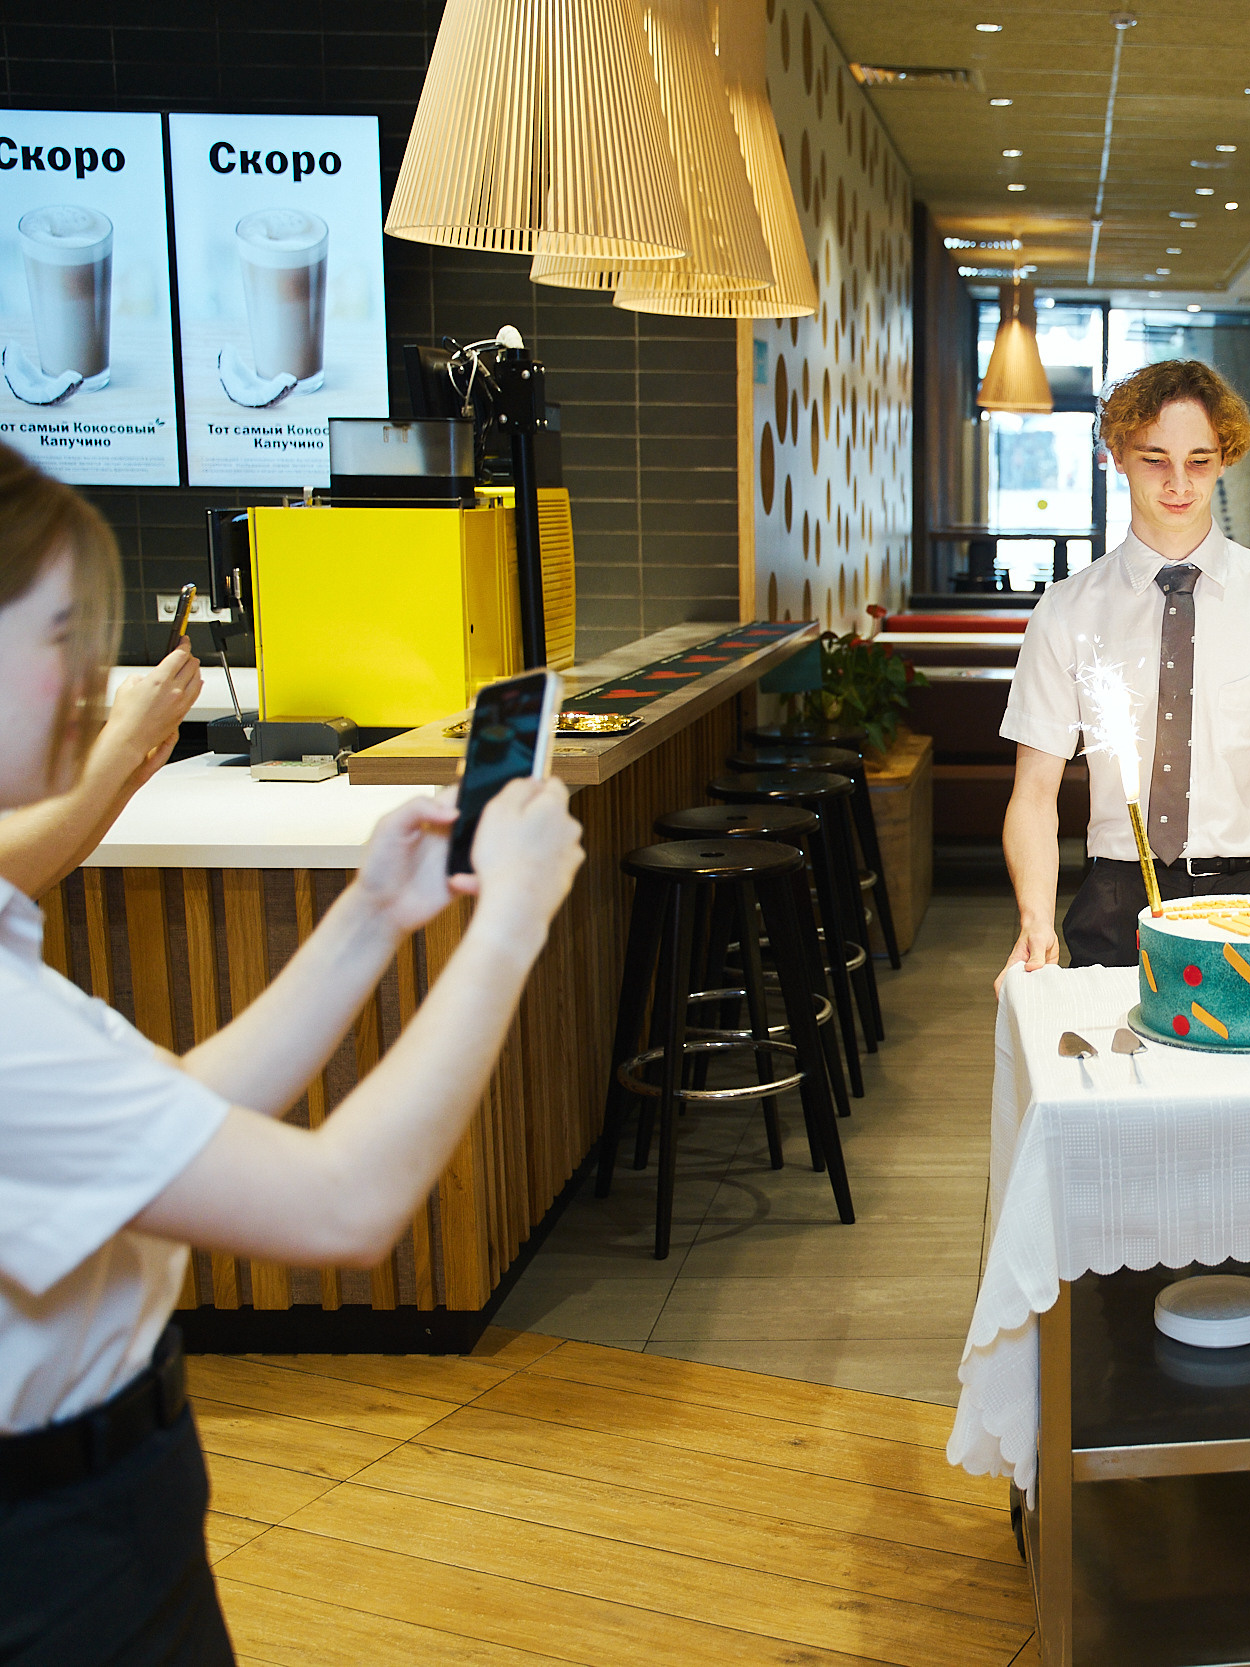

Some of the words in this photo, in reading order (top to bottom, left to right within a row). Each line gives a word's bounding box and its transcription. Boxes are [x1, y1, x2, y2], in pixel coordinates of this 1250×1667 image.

[0, 136, 126, 179] Скоро
[209, 141, 342, 183] Скоро
[0, 423, 16, 433] от
[20, 420, 69, 433] самый
[73, 421, 156, 434] Кокосовый
[208, 424, 229, 435] Тот
[233, 423, 283, 435] самый
[287, 424, 329, 436] Кокос
[40, 435, 112, 449] Капучино
[254, 438, 324, 452] Капучино
